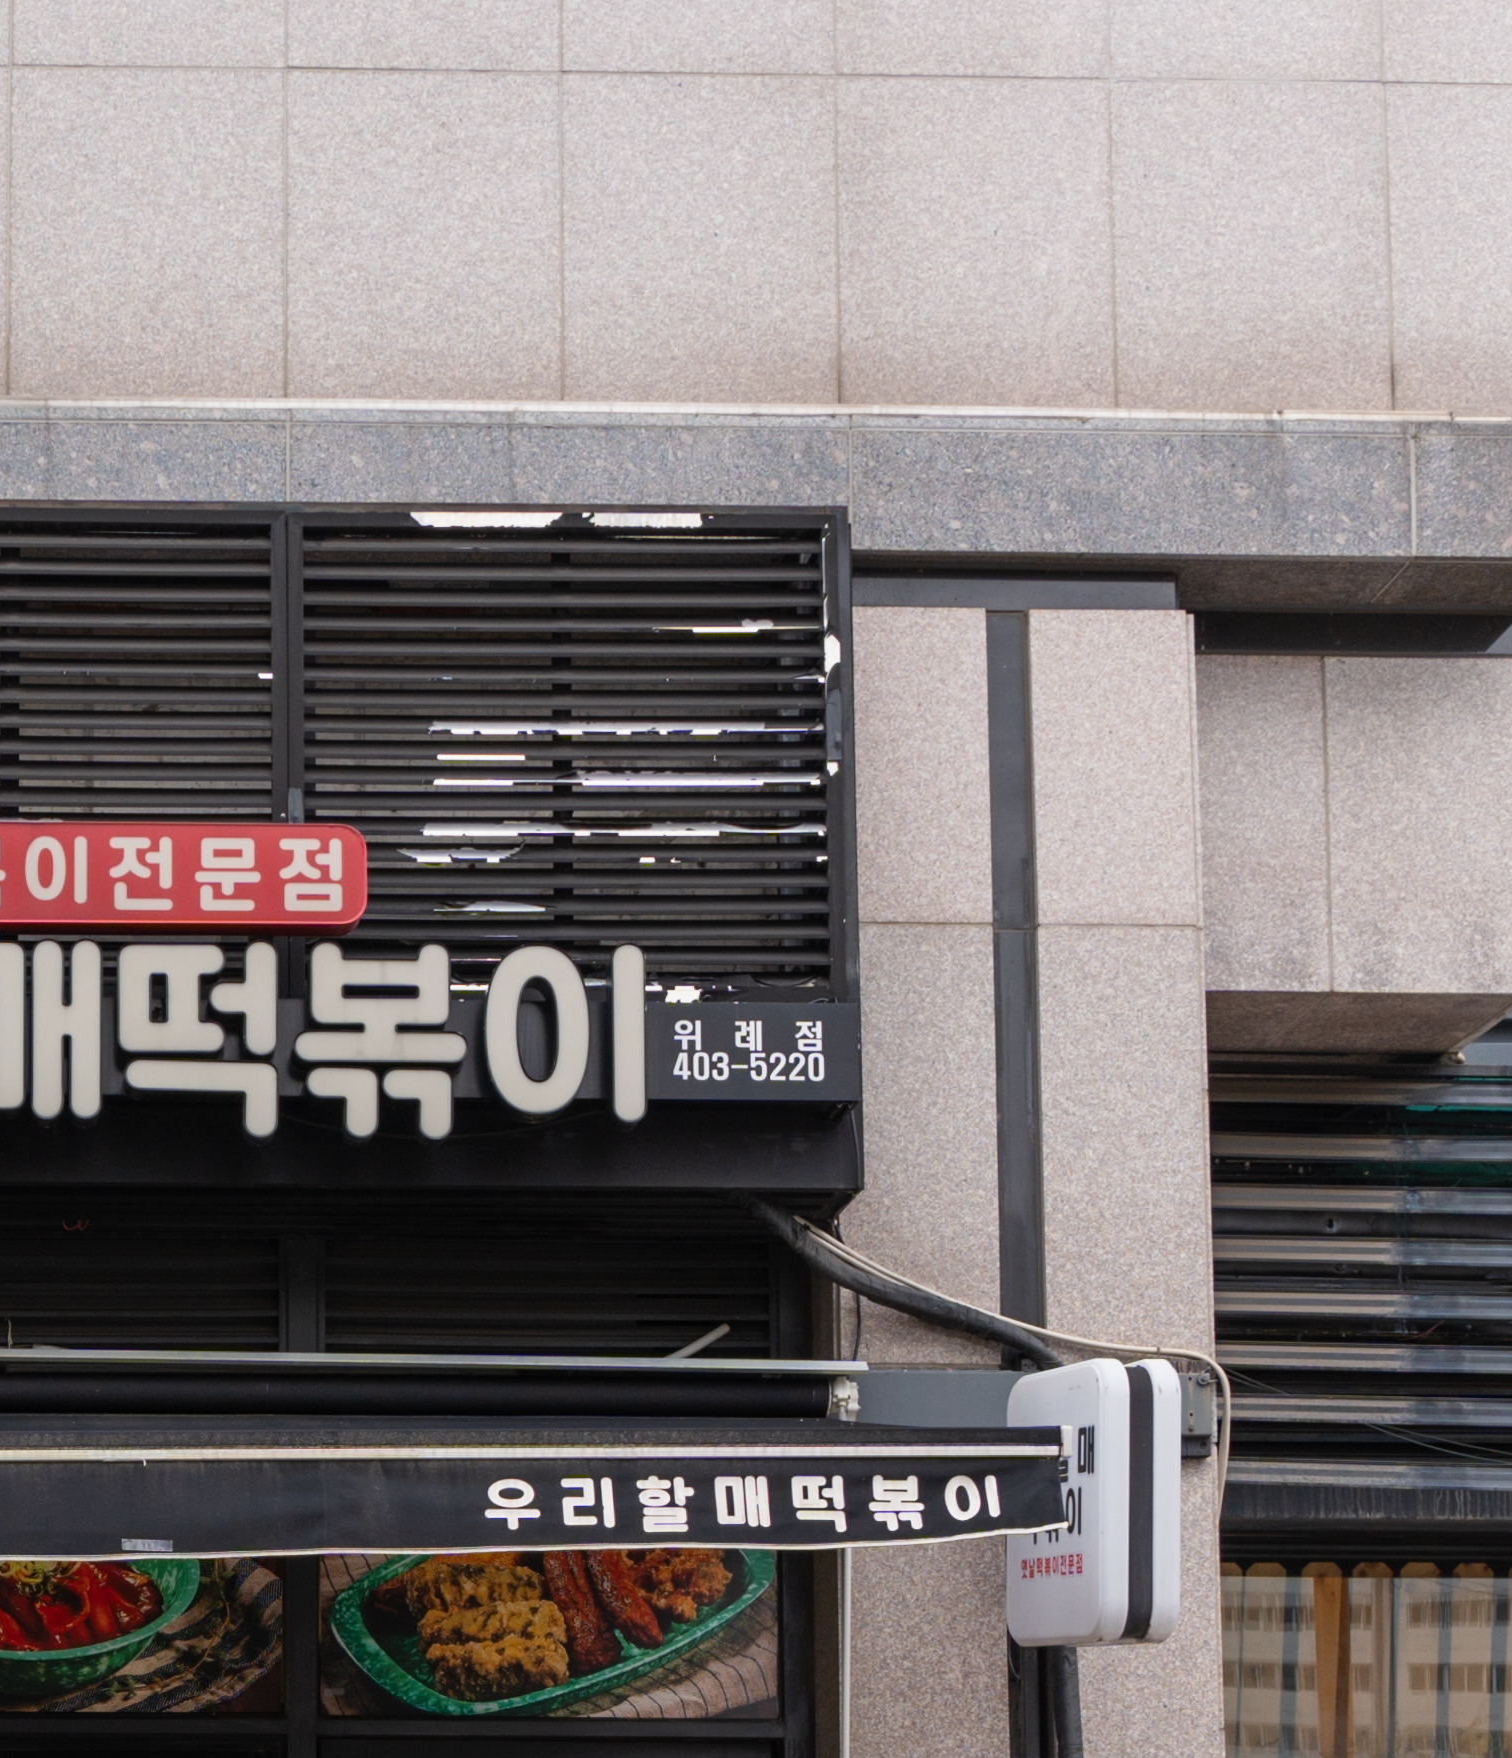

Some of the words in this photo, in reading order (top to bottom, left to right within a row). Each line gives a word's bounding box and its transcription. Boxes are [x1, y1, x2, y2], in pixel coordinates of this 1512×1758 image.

[671, 1017, 826, 1052] 위례점
[672, 1051, 827, 1083] 403-5220
[484, 1473, 1001, 1535] 우리할매떡볶이
[1020, 1553, 1084, 1579] 옛날떡볶이전문점
